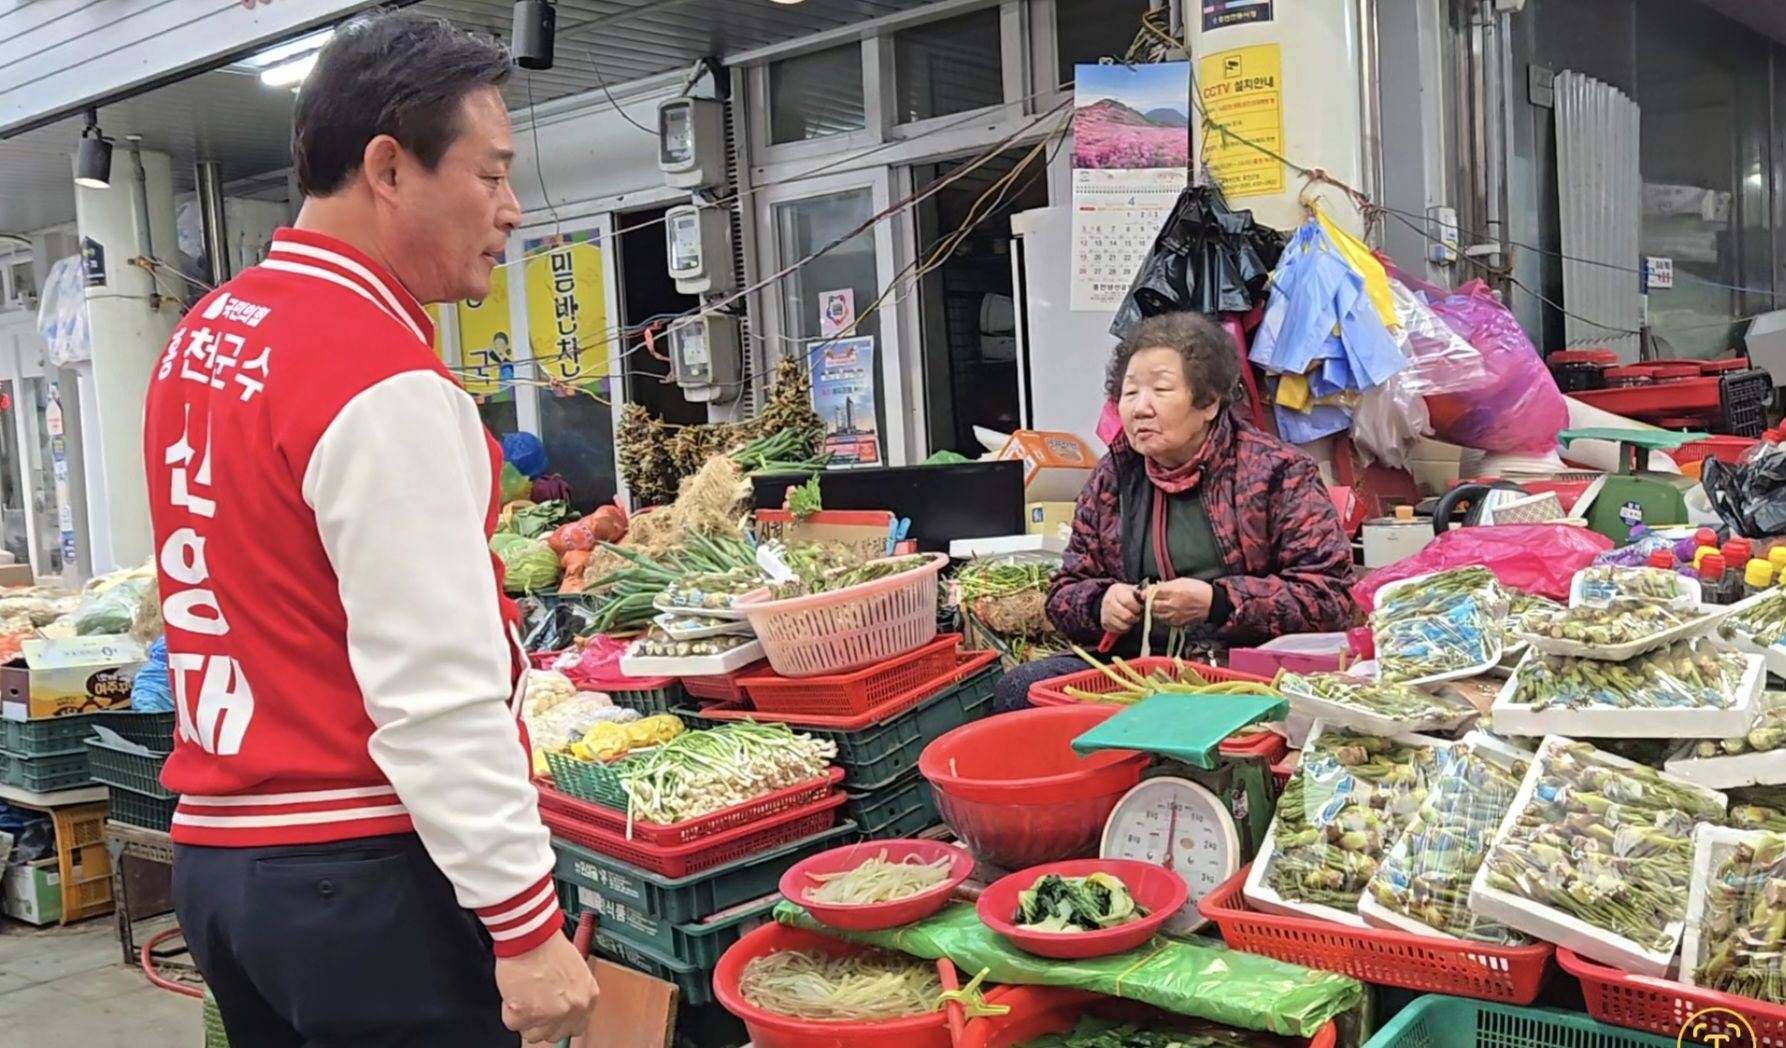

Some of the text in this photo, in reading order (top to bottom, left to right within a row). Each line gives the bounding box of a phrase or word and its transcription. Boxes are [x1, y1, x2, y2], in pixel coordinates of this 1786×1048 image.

[1203, 76, 1275, 99] CCTV 설치안내
[1127, 196, 1135, 206] 4
[222, 298, 272, 328] 국민의힘
[551, 252, 580, 378] 밑반찬
[158, 327, 271, 402] 홍천군수
[1204, 840, 1217, 850] 2kg
[1201, 873, 1214, 883] 3kg
